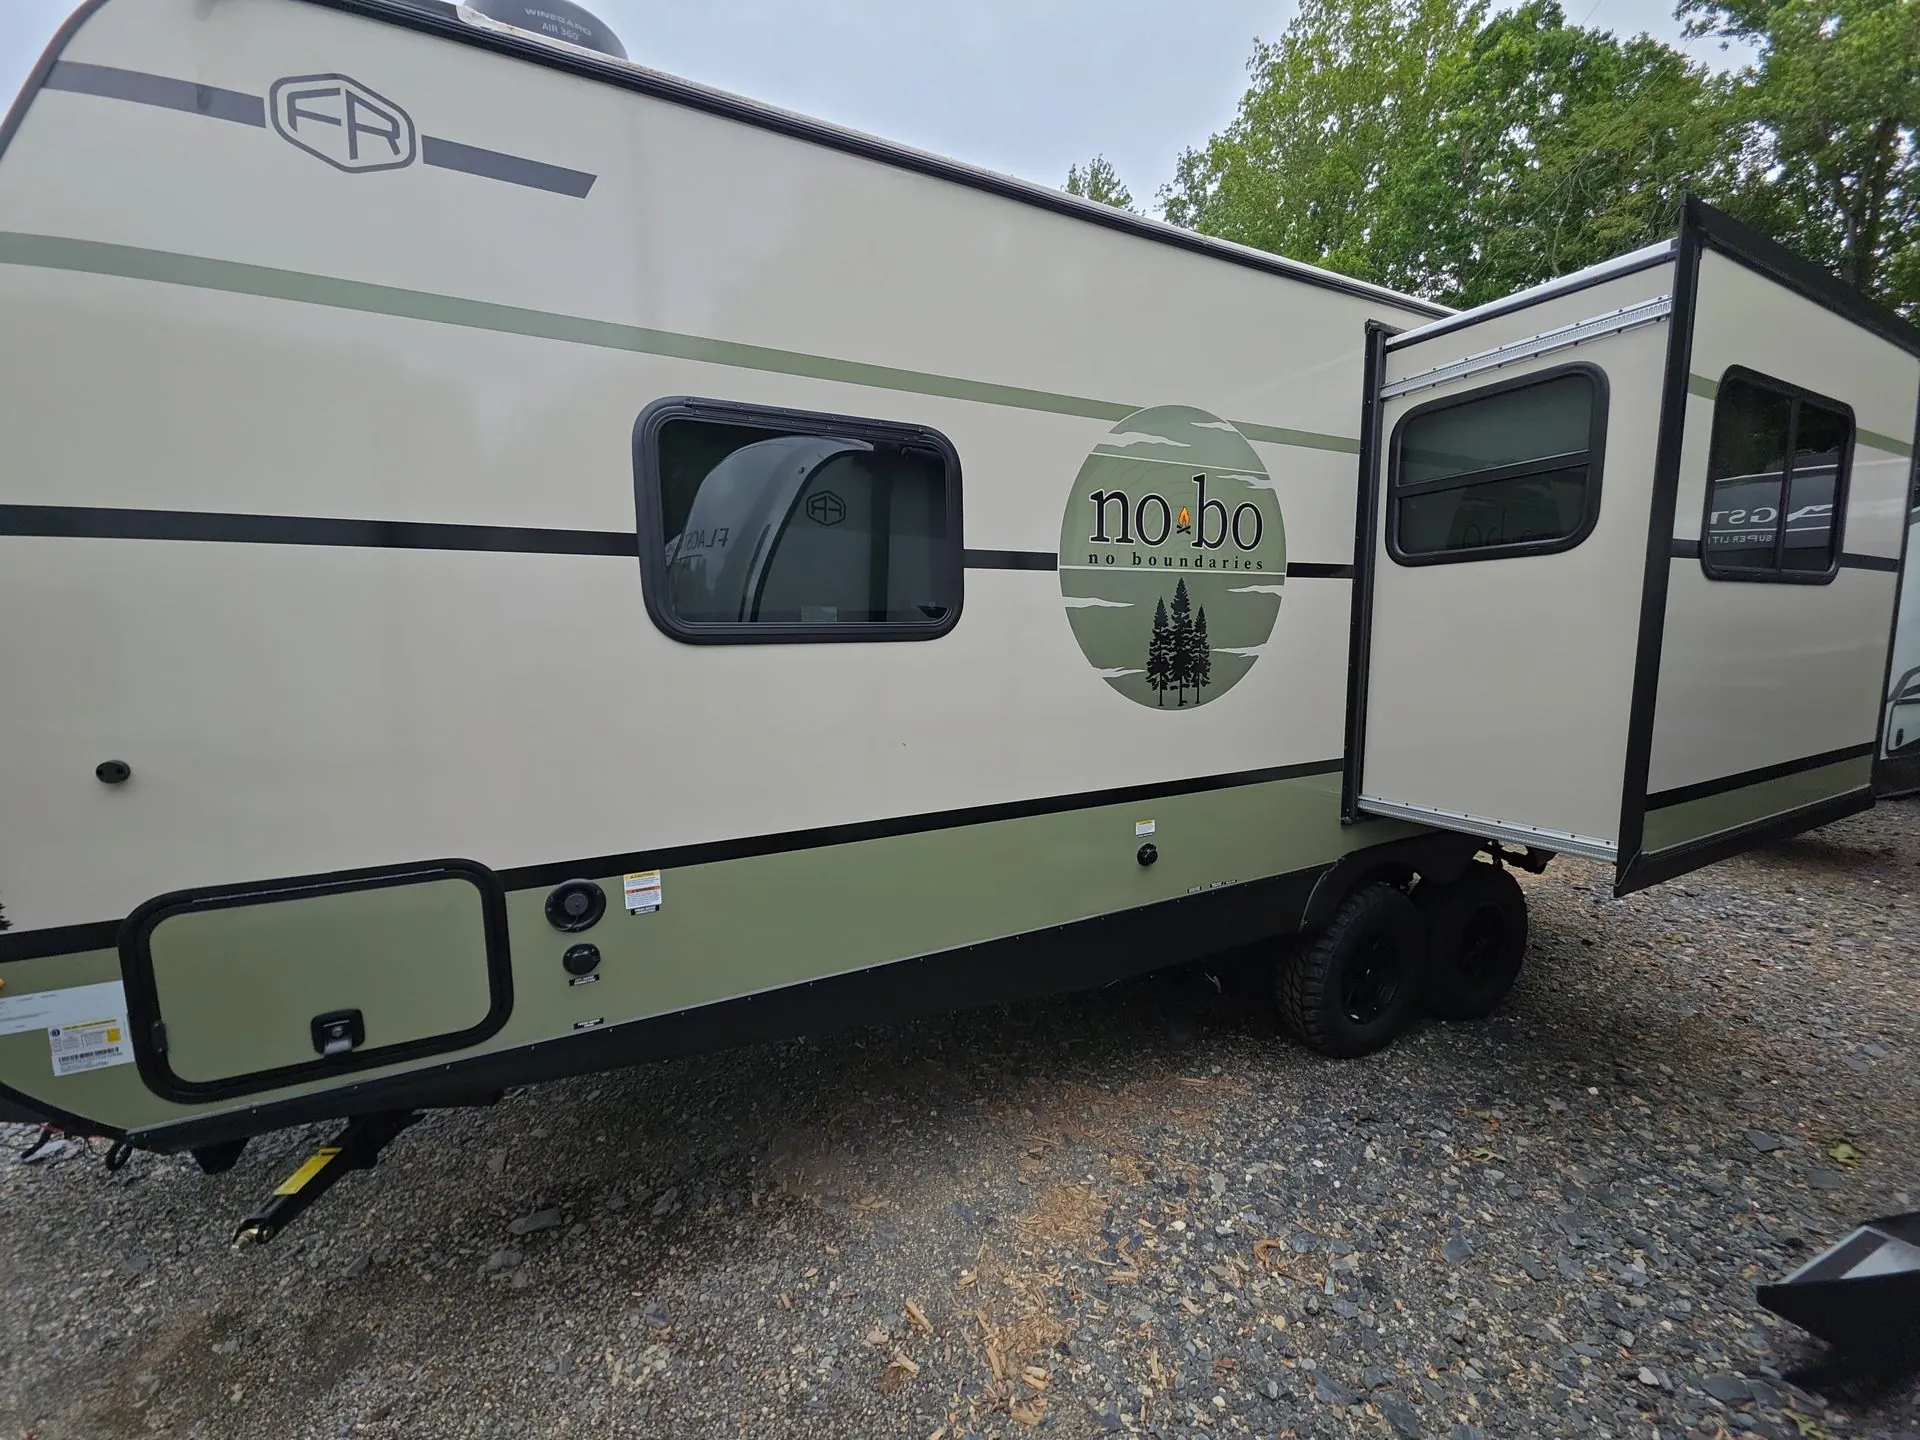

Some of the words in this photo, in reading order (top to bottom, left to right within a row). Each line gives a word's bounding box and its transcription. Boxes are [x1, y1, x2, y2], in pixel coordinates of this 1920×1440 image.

[541, 22, 559, 35] AIR
[561, 27, 579, 40] 360
[1088, 553, 1115, 565] no
[1132, 552, 1264, 570] boundaries
